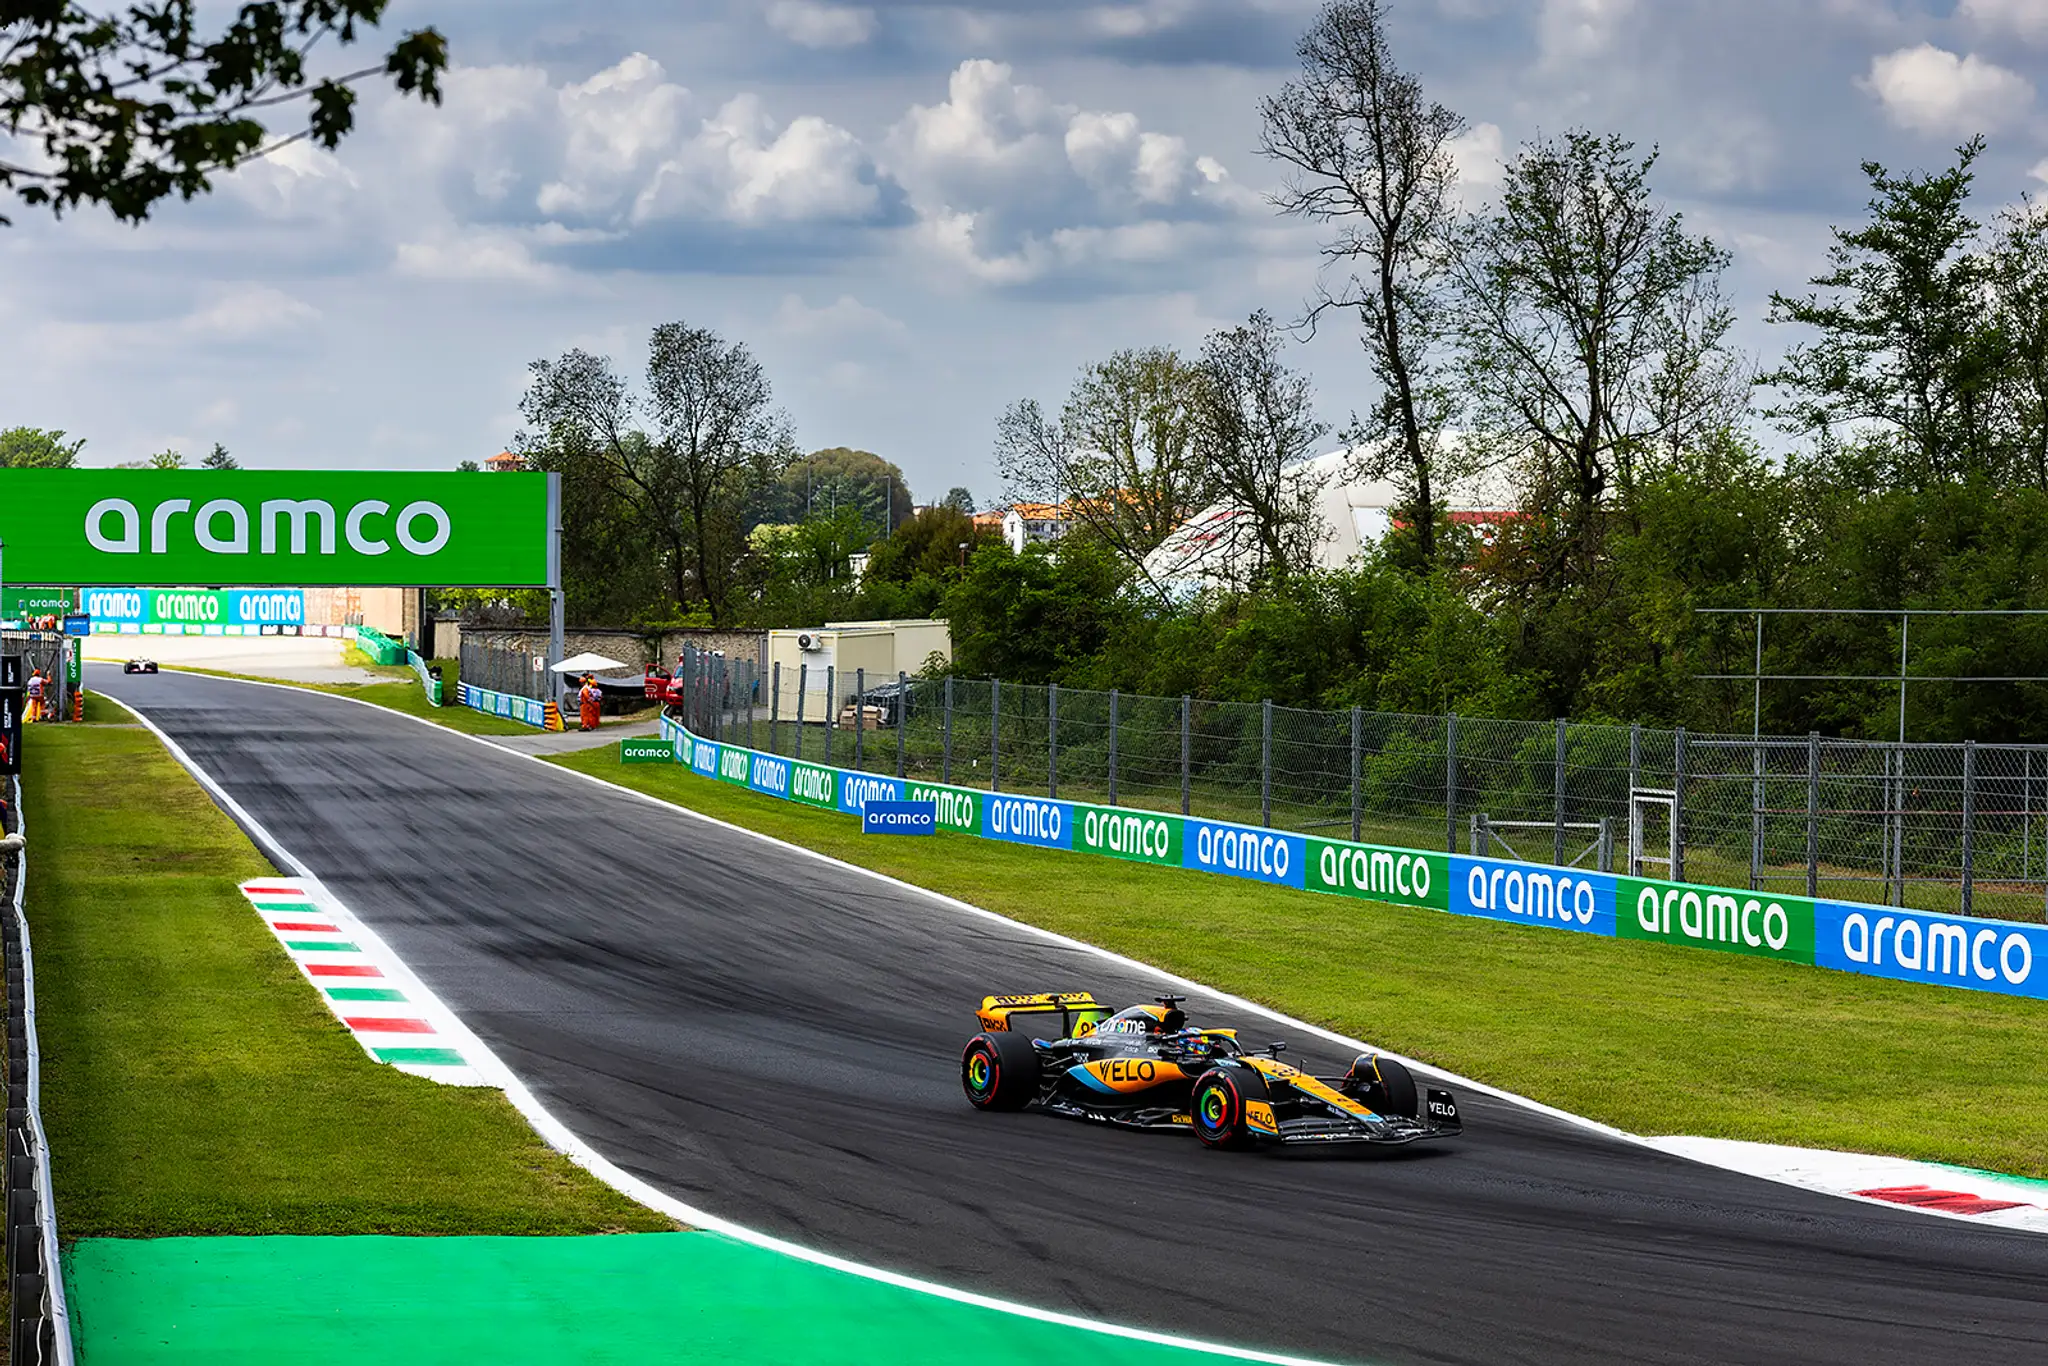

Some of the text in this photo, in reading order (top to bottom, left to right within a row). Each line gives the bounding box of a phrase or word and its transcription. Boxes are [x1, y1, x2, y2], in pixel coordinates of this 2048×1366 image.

[84, 498, 451, 556] aramco
[29, 599, 70, 608] aramco
[89, 592, 141, 618] aramco
[156, 593, 219, 621] aramco
[239, 594, 301, 622] aramco
[624, 748, 671, 758] aramco
[753, 757, 786, 792] aramco
[793, 766, 832, 803] aramco
[868, 813, 931, 825] aramco
[991, 798, 1061, 841] aramco
[1084, 810, 1169, 858] aramco
[1198, 826, 1289, 878] aramco
[1320, 845, 1431, 899] aramco
[1468, 865, 1595, 925] aramco
[1637, 886, 1790, 952] aramco
[1842, 912, 2033, 985] aramco
[1099, 1060, 1156, 1082] VELO
[1250, 1110, 1274, 1125] VELO
[1428, 1101, 1456, 1117] VELO
